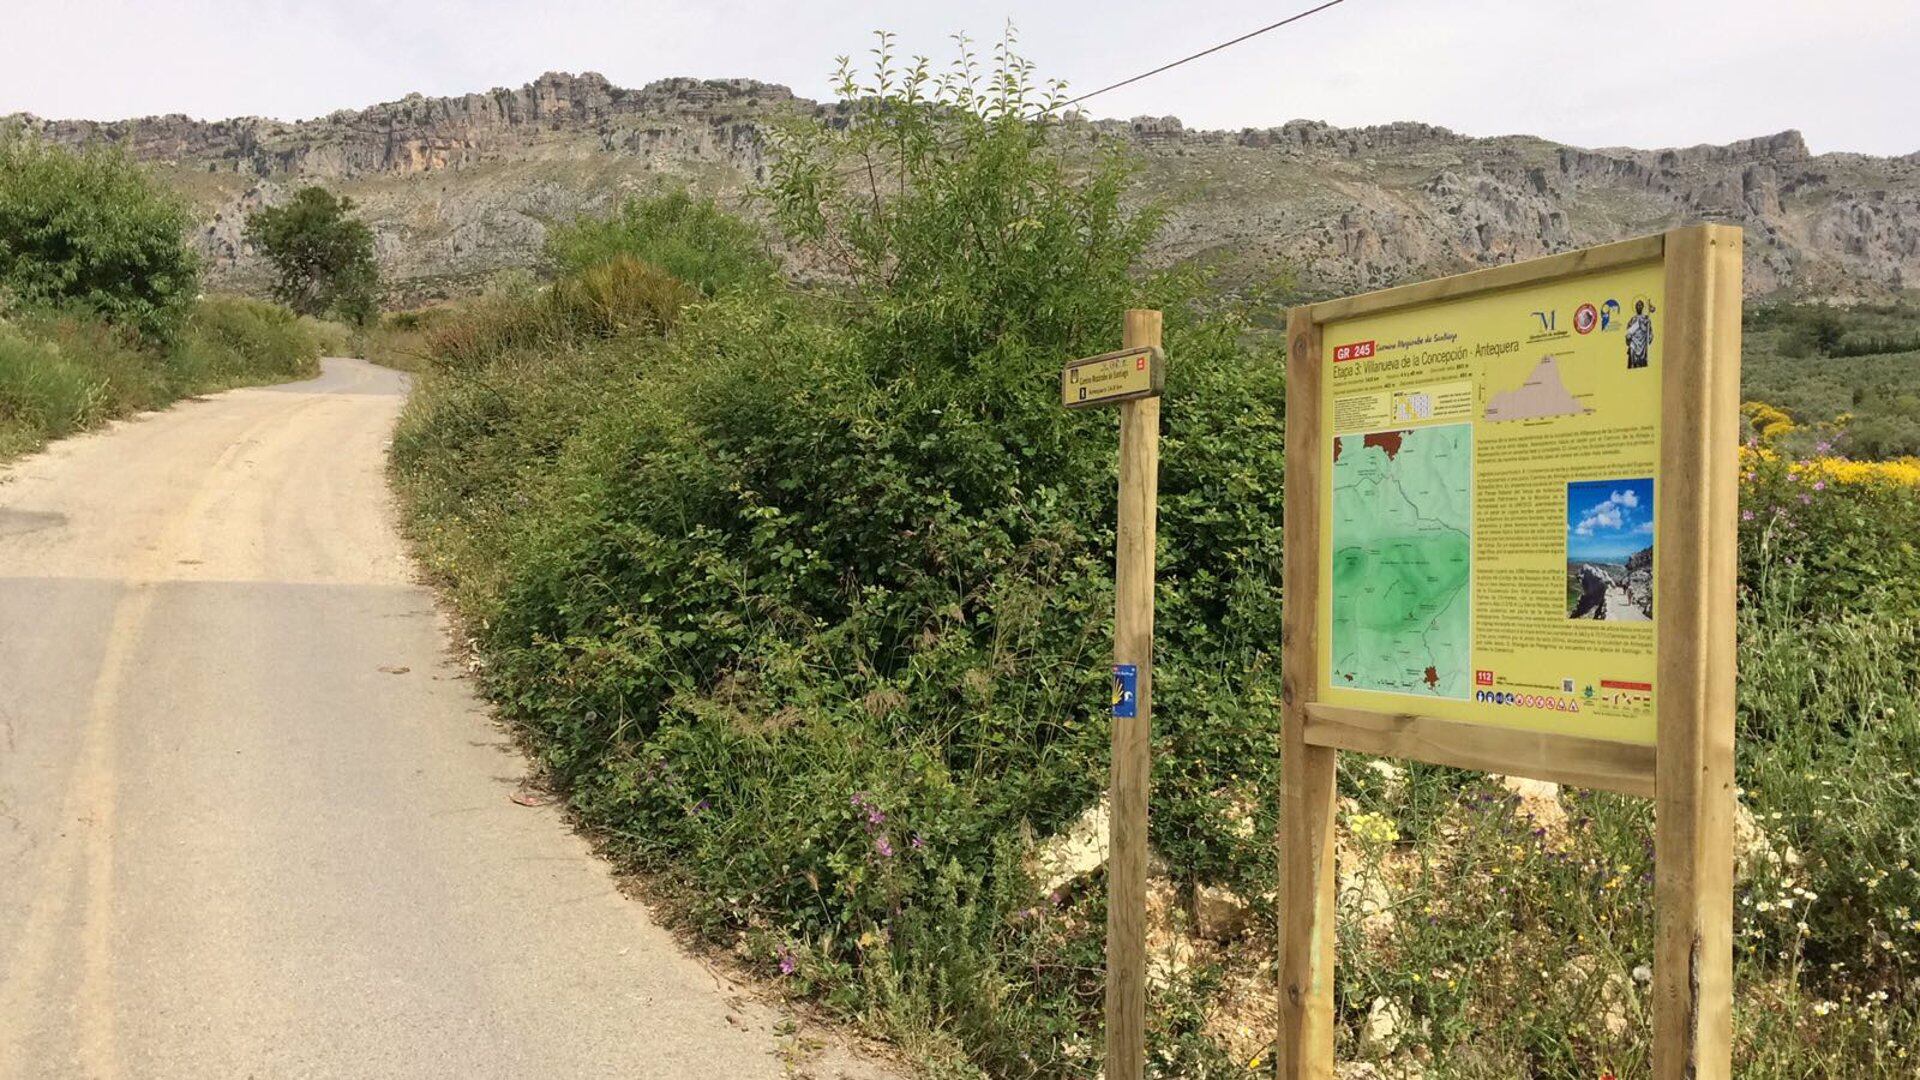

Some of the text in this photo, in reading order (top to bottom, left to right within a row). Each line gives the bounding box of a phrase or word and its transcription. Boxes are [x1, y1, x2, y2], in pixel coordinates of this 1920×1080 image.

[1434, 332, 1458, 343] Santiago
[1337, 343, 1371, 360] GR 245
[1333, 365, 1354, 380] Etapa
[1363, 358, 1400, 374] Villanueva
[1401, 354, 1411, 369] de
[1413, 353, 1420, 367] la
[1421, 345, 1469, 365] Concepción
[1475, 340, 1520, 358] Antequera
[1477, 671, 1492, 682] 112
